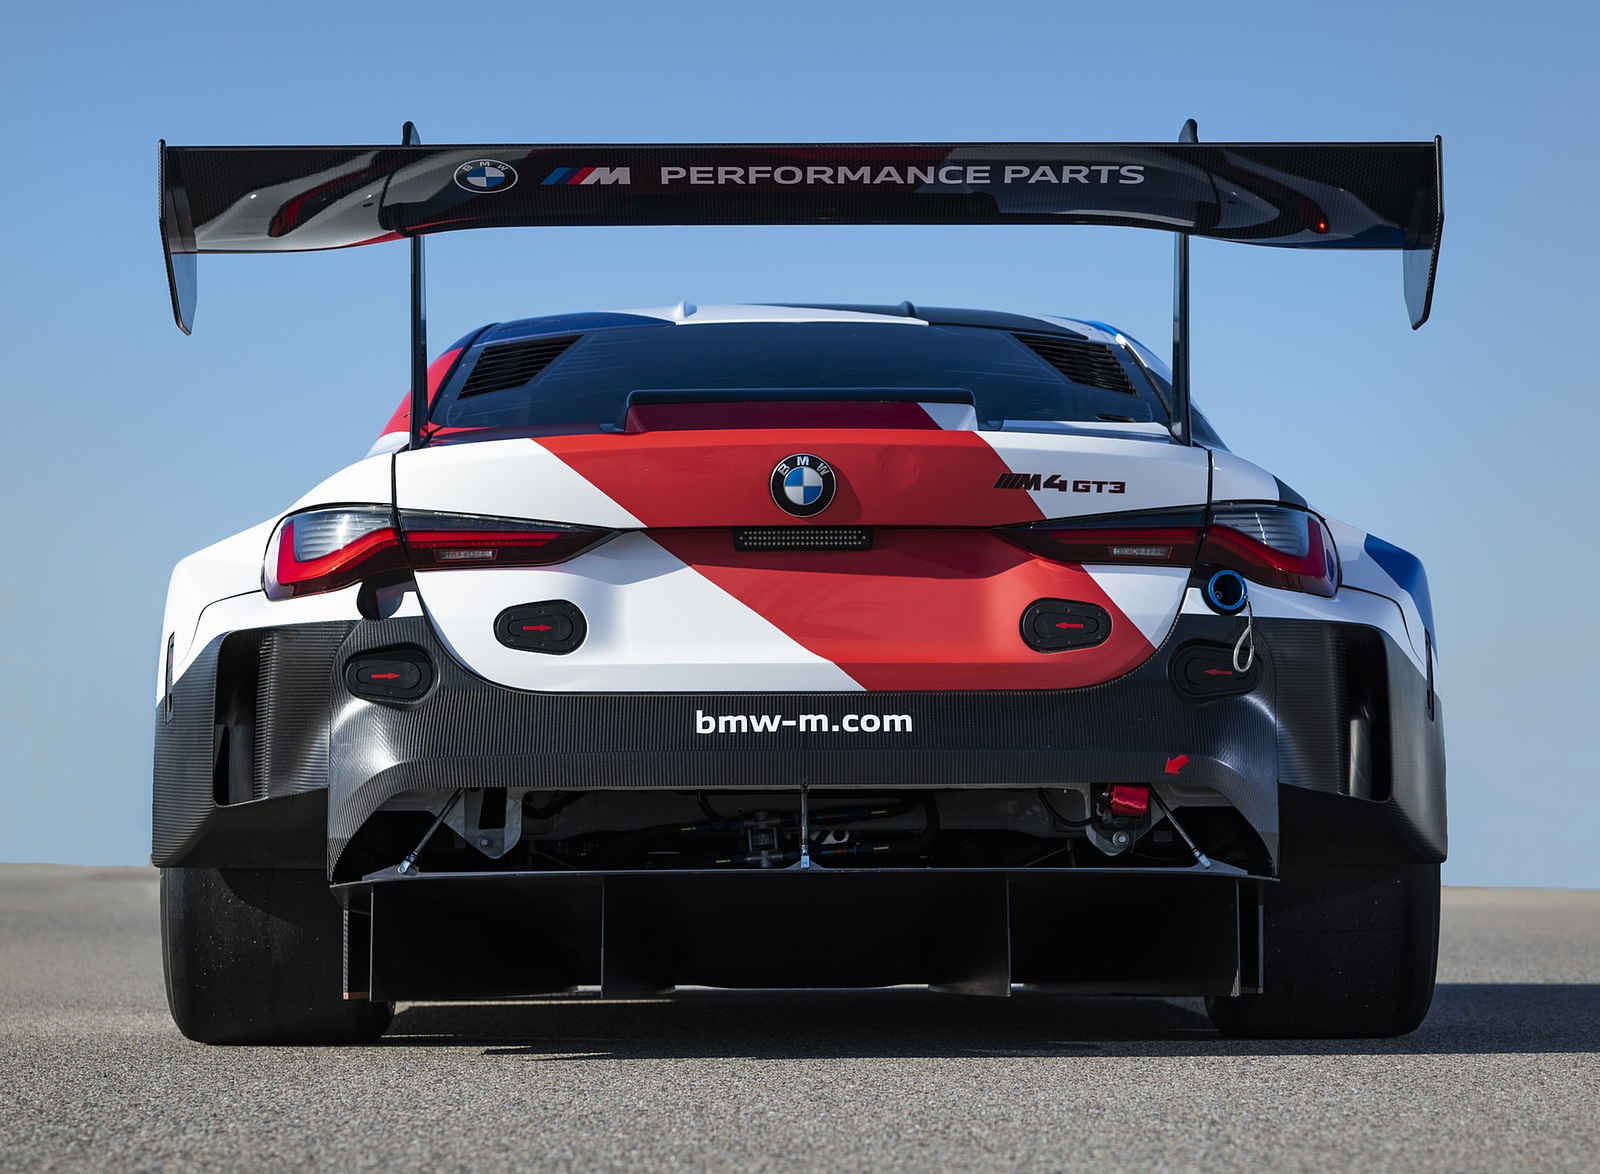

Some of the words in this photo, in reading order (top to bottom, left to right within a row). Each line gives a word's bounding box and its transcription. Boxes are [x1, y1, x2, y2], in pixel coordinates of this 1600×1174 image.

[462, 161, 509, 172] BMW
[660, 166, 991, 184] PERFORMANCE
[1003, 165, 1145, 184] PARTS
[777, 456, 830, 476] BMW
[1014, 473, 1068, 492] M4
[1072, 480, 1126, 494] GT3
[696, 709, 913, 734] bmw-m.com
